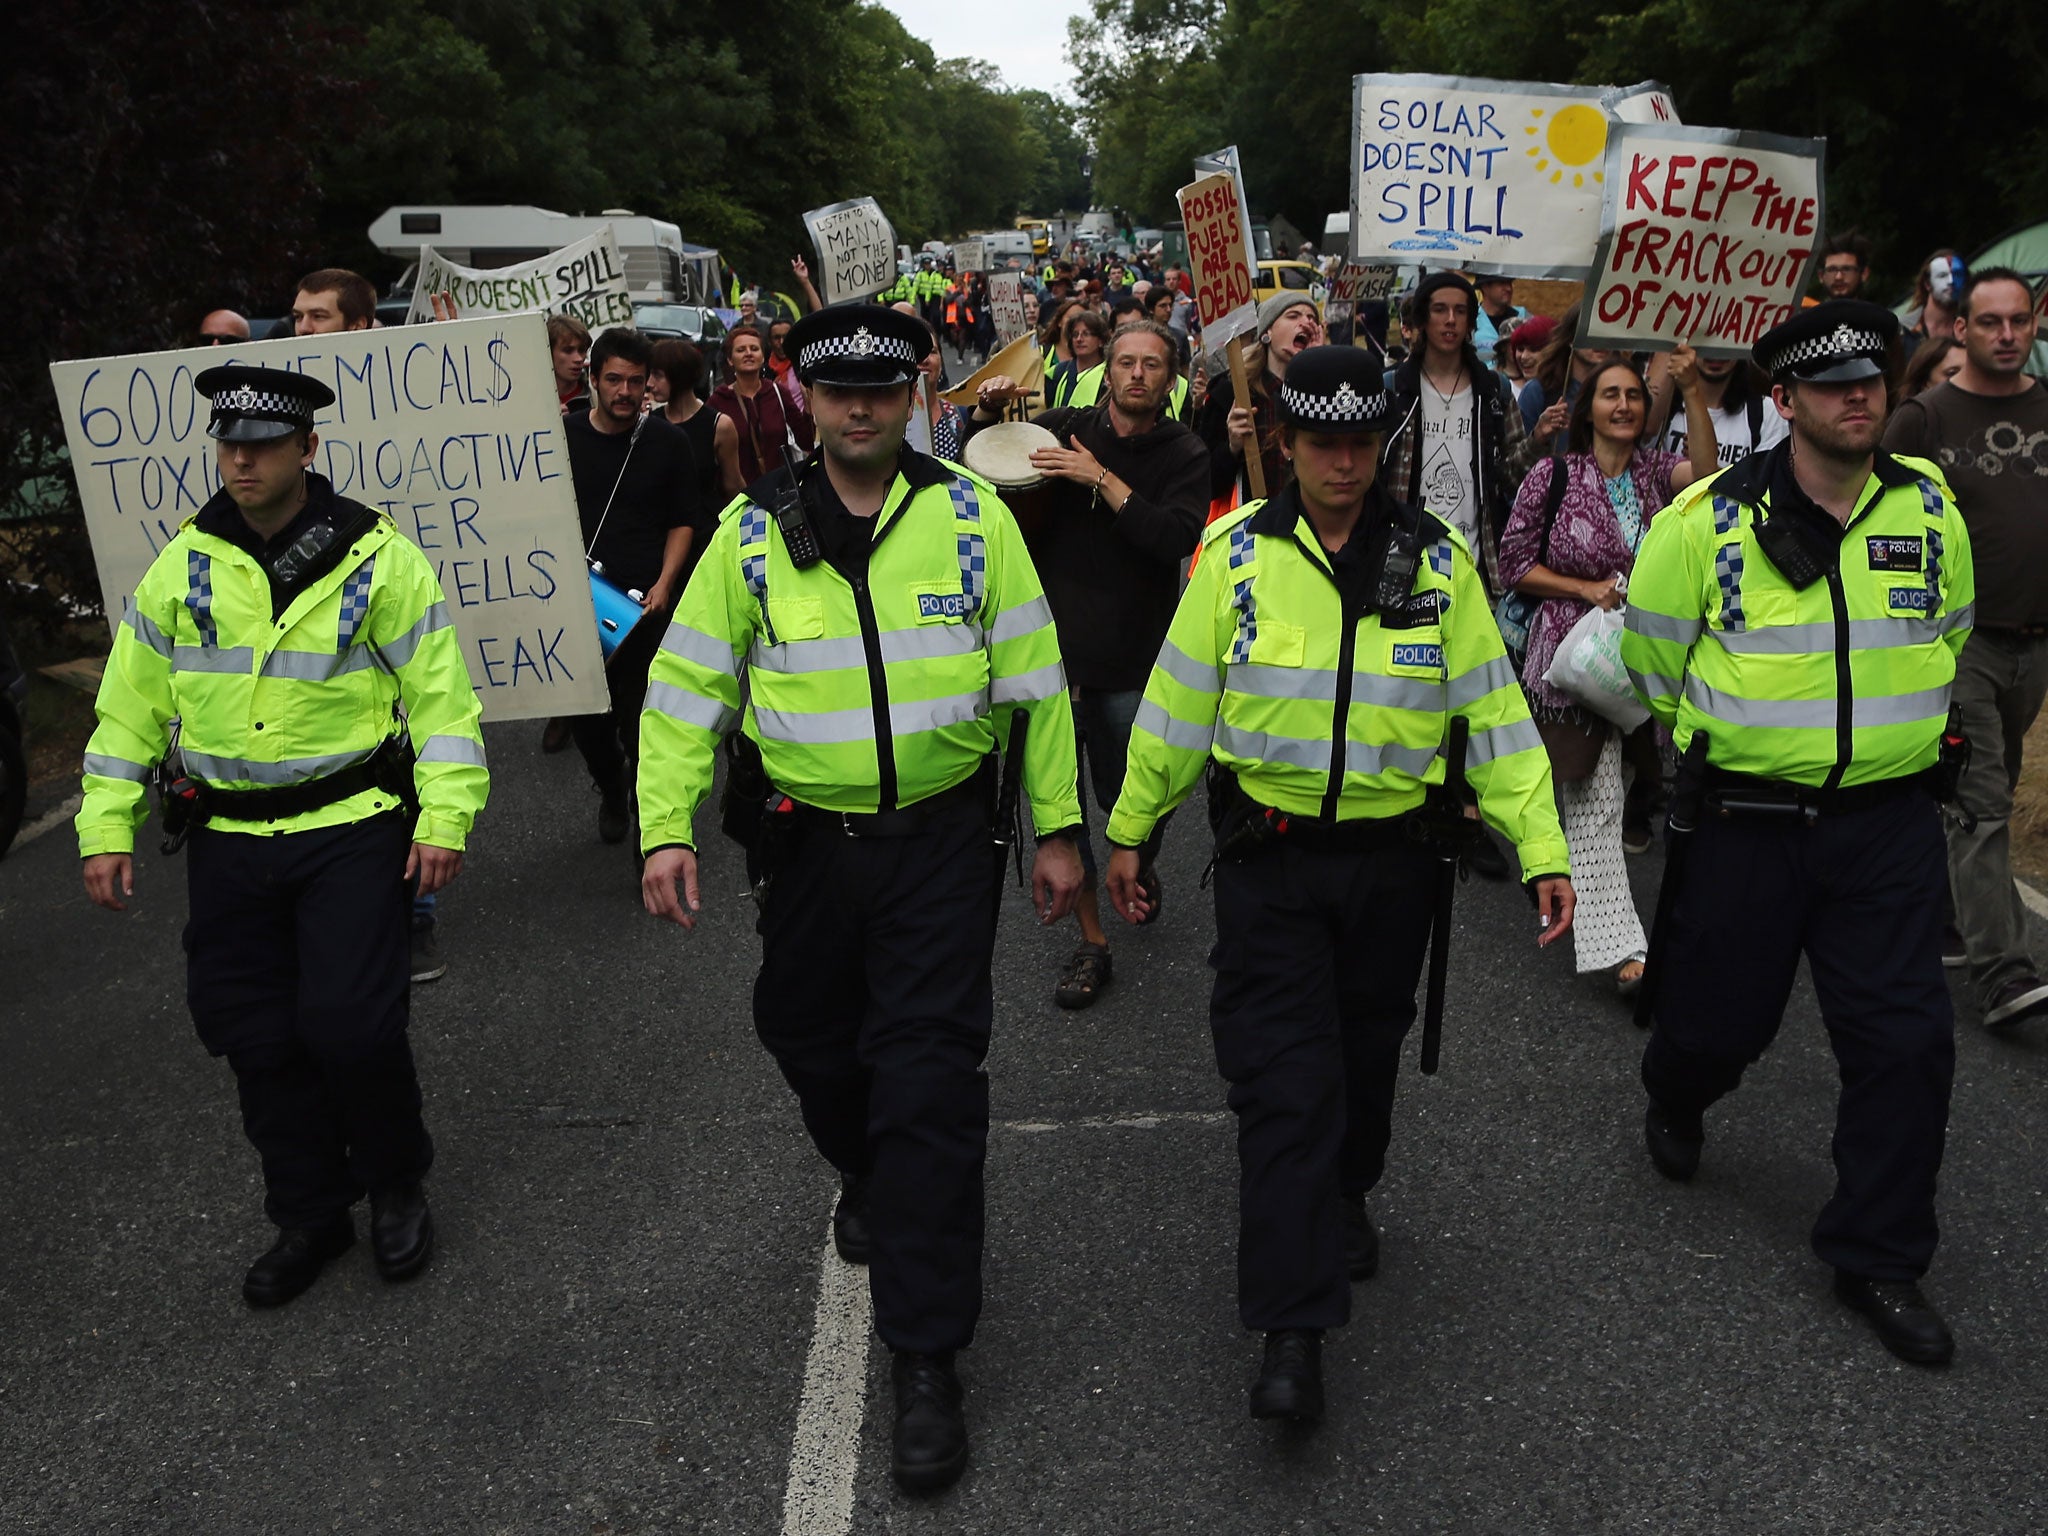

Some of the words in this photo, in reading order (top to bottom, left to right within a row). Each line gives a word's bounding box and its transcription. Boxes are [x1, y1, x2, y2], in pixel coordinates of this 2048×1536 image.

[1378, 100, 1506, 140] SOLAR
[1363, 142, 1508, 180] DOESNT
[1183, 181, 1238, 232] FOSSIL
[1626, 152, 1759, 223] KEEP
[816, 212, 850, 232] LISTEN
[1378, 182, 1524, 239] SPILL
[827, 219, 880, 253] MANY
[836, 247, 857, 267] NOT
[863, 238, 888, 259] THE
[1187, 211, 1239, 262] FUELS
[1611, 219, 1743, 286] FRACK
[1739, 248, 1812, 289] OUT
[466, 270, 551, 311] DOESN'T
[556, 246, 623, 296] SPILL
[836, 256, 889, 293] MONEY
[1202, 244, 1231, 281] ARE
[1198, 262, 1251, 327] DEAD
[1333, 279, 1355, 300] NO
[561, 292, 632, 330] ABLES
[1598, 280, 1662, 329] OF
[1653, 290, 1712, 341] MY
[80, 365, 195, 447] 600
[1889, 545, 1920, 554] POLICE
[920, 596, 964, 614] POICE
[1890, 591, 1926, 607] POICE
[473, 628, 575, 691] EAK
[1394, 647, 1441, 664] POLICE
